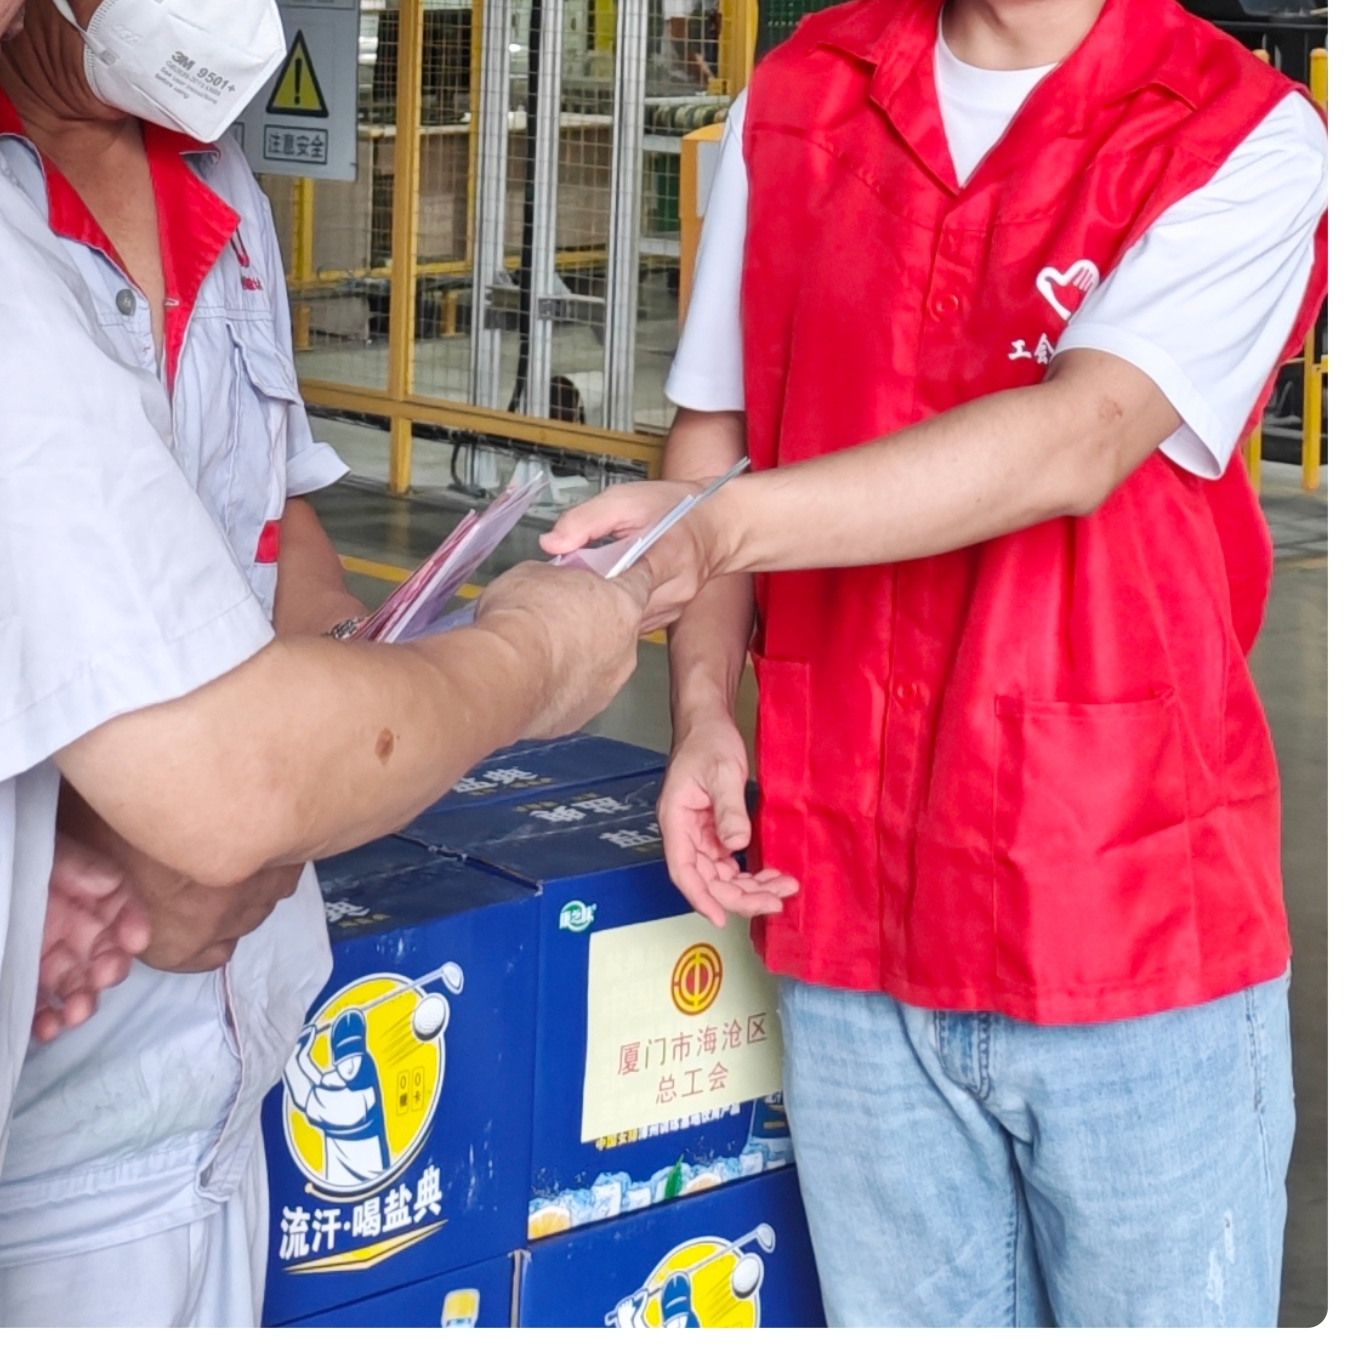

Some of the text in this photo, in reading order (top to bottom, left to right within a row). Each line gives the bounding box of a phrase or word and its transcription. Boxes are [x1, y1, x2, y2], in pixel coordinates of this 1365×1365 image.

[171, 50, 236, 93] 3M 9501+
[268, 131, 324, 159] 注意安全
[617, 1011, 768, 1077] 厦门市海沧区
[655, 1061, 730, 1106] 总工会
[278, 1164, 443, 1260] 流汗·喝盐典
